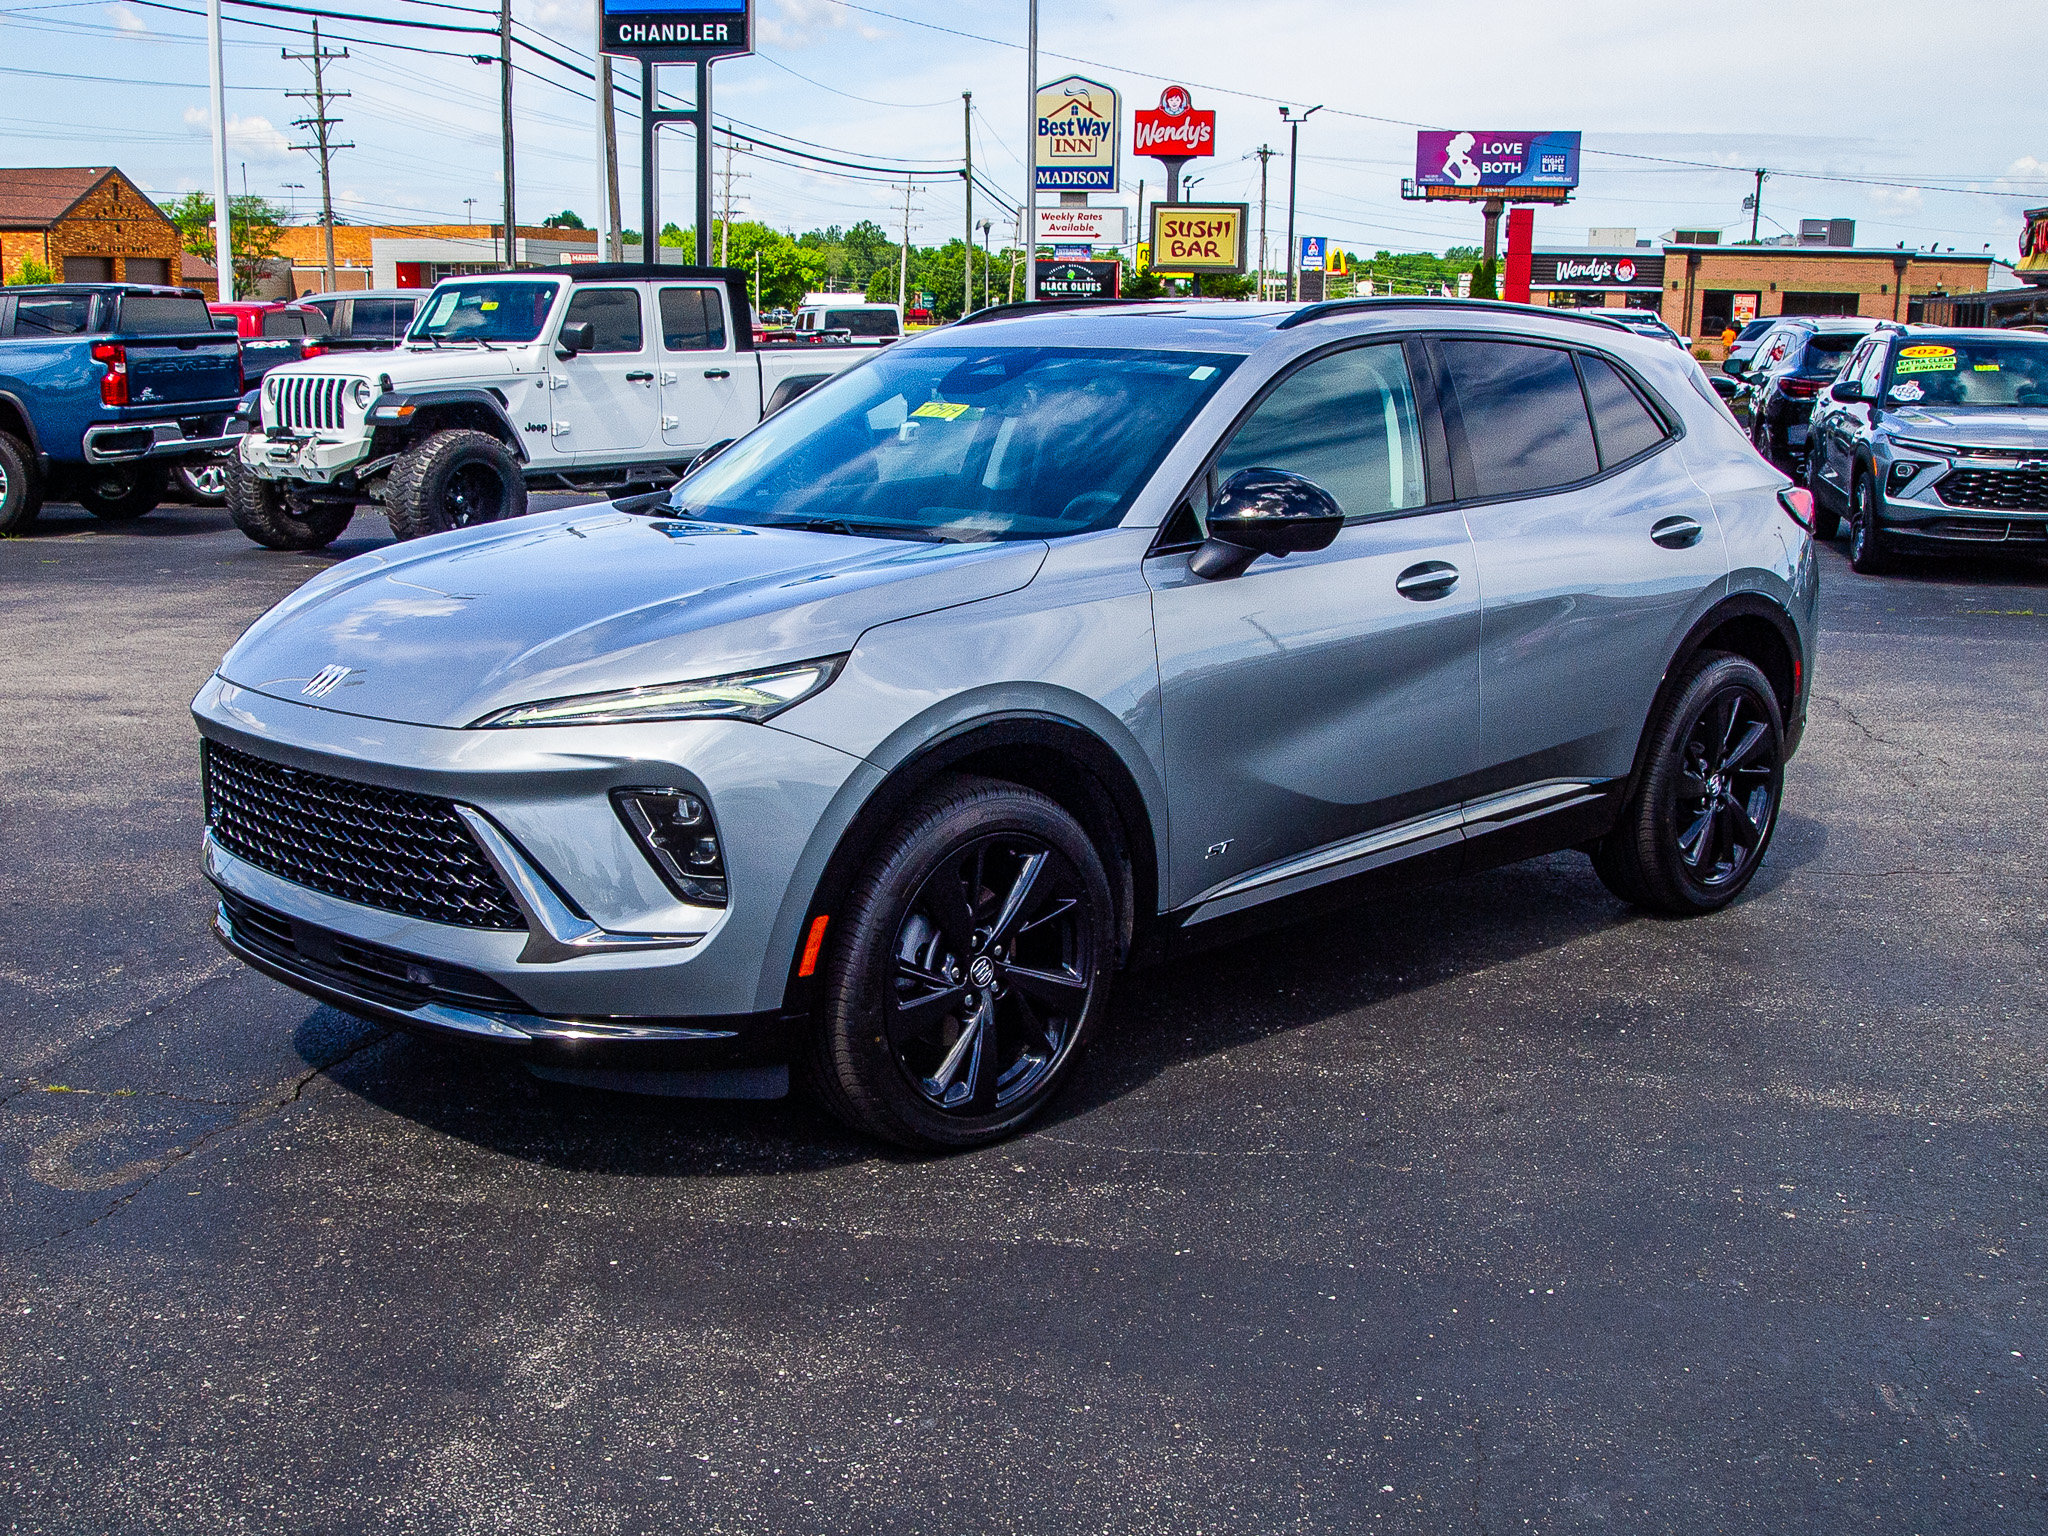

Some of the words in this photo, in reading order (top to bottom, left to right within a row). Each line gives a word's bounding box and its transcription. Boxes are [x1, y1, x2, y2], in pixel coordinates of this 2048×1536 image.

[619, 23, 729, 42] CHANDLER
[1037, 117, 1075, 137] Best
[1076, 117, 1112, 143] Way
[1136, 117, 1211, 149] Wendy's
[1054, 138, 1093, 153] INN
[1482, 142, 1523, 155] LOVE
[1499, 154, 1521, 162] them
[1541, 158, 1566, 166] RIGHT
[1481, 161, 1522, 174] BOTH
[1541, 164, 1566, 173] LIFE
[1036, 171, 1110, 185] MADISON
[1041, 212, 1075, 223] Weekly
[1077, 212, 1103, 221] Rates
[1048, 223, 1095, 232] Available
[1164, 221, 1231, 238] SUSHI
[1170, 240, 1221, 258] BAR
[1556, 258, 1612, 282] Wendy's
[1040, 282, 1068, 292] BLACK
[1071, 282, 1102, 292] OLIVES
[1906, 348, 1949, 356] 2024
[524, 422, 548, 434] Jeep
